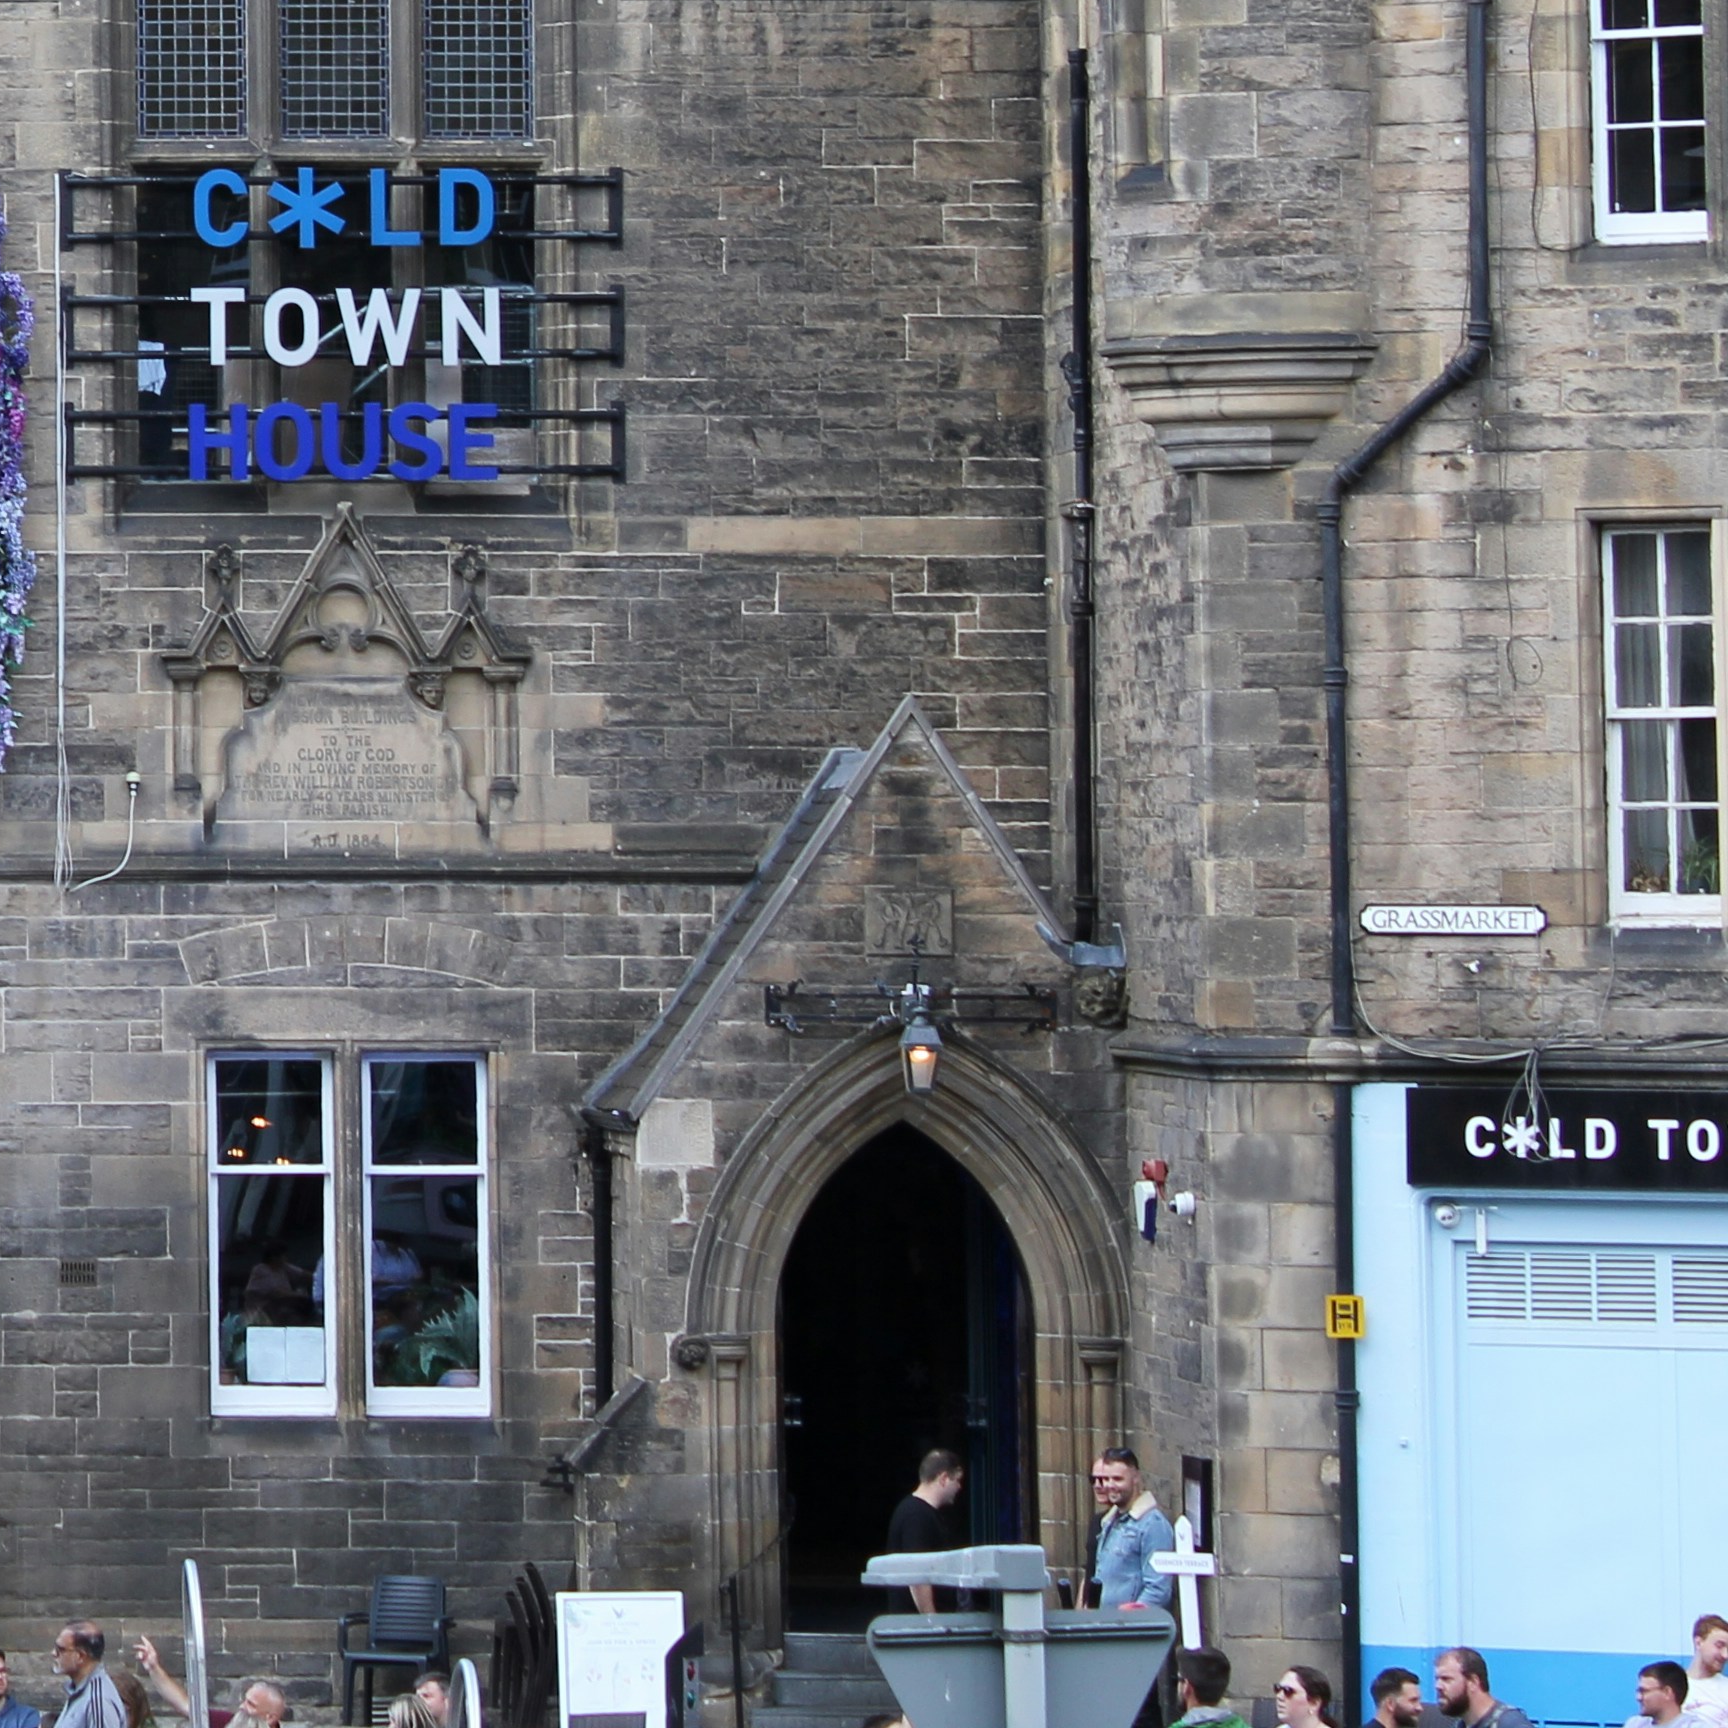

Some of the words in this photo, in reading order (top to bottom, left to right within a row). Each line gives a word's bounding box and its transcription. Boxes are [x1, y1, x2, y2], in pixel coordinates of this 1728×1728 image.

[190, 287, 501, 366] TOWN
[188, 402, 499, 481] HOUSE
[341, 709, 417, 725] BUILDINGS
[321, 735, 337, 746] TO
[347, 735, 372, 746] THE
[297, 748, 342, 761] GLORY
[365, 749, 395, 761] GOD
[288, 762, 301, 774] IN
[309, 762, 356, 774] LOVING
[362, 763, 416, 775] MEMORY
[421, 763, 437, 775] OF
[294, 775, 352, 789] WILLIAM
[357, 775, 433, 790] ROBERTSON
[267, 790, 313, 802] NEARLY
[337, 791, 374, 803] YEARS
[378, 791, 436, 804] MINISTER
[1371, 909, 1534, 931] GRASSMARKET
